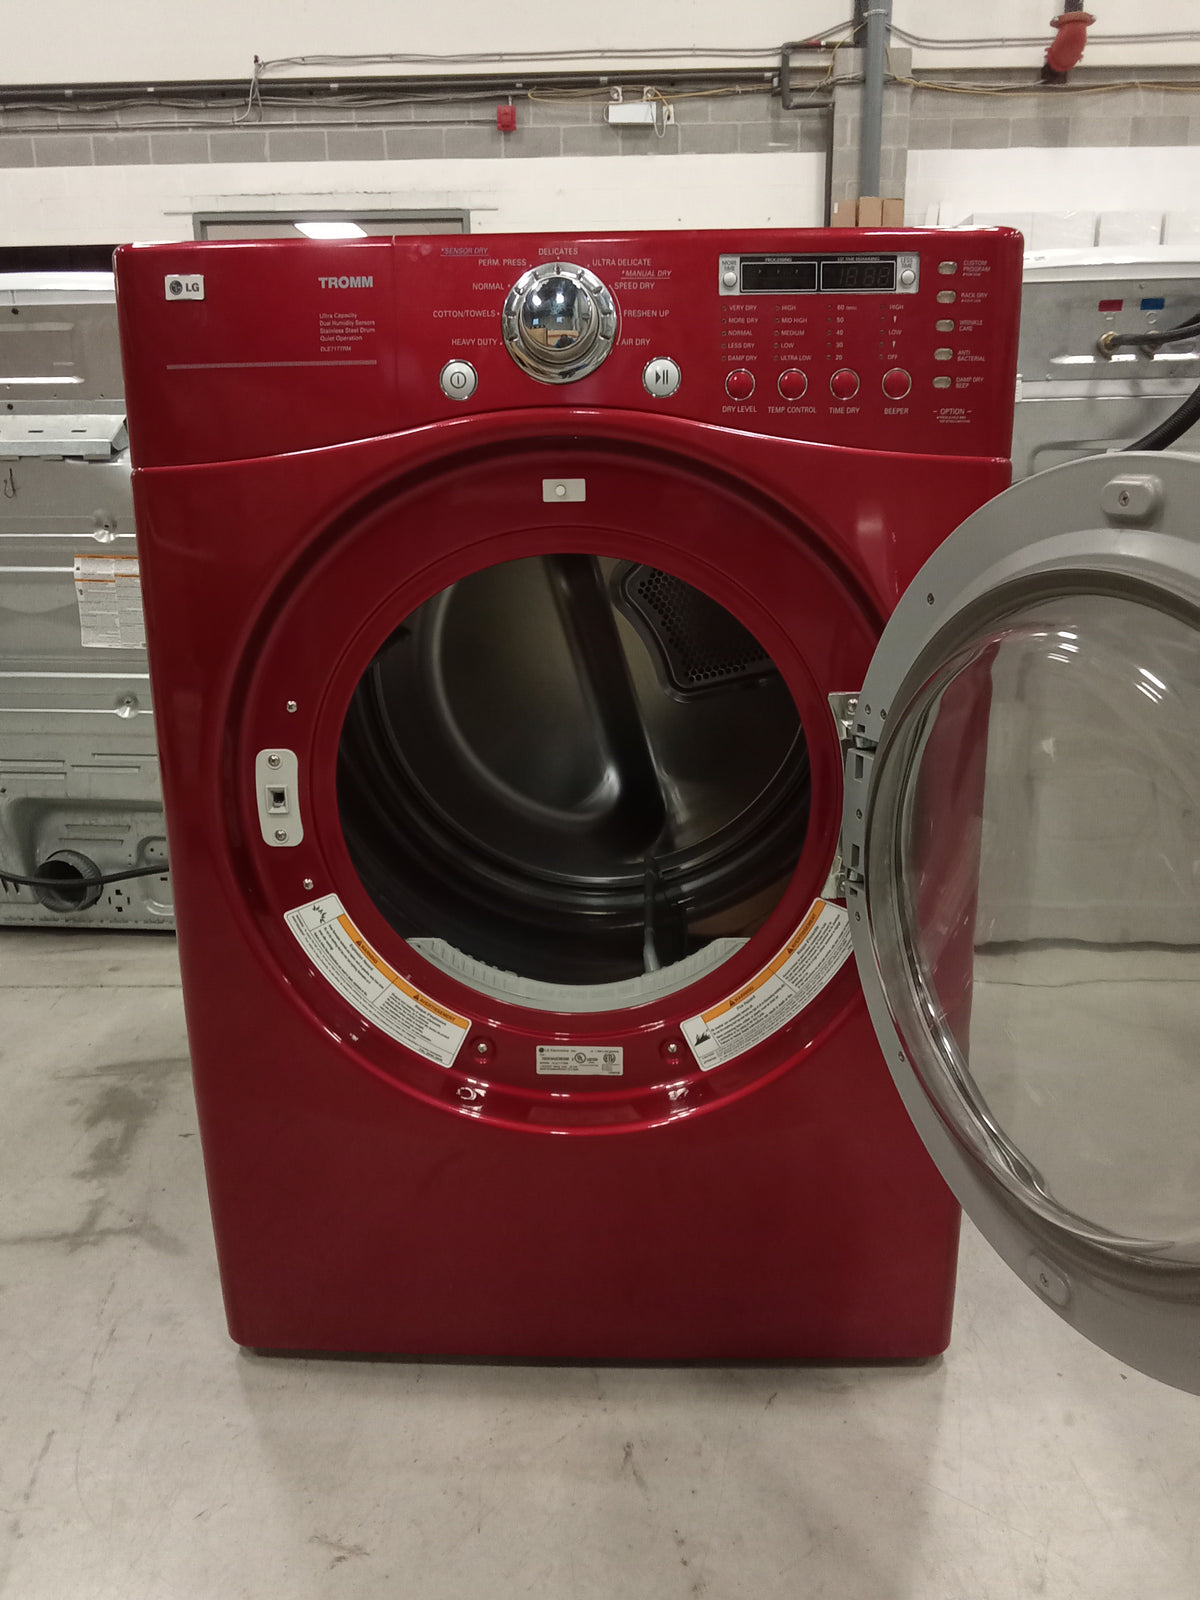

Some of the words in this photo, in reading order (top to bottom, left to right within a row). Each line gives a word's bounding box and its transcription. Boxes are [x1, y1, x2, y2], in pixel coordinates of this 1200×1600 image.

[592, 258, 616, 266] ULTRA
[618, 258, 651, 266] DELICATE
[318, 276, 373, 289] TROMM
[614, 282, 638, 290] SPEED
[640, 282, 655, 290] DRY
[186, 282, 199, 292] LG
[433, 309, 496, 318] COTTON/TOWELS
[452, 338, 475, 346] HEAVY
[477, 338, 497, 346] DUTY
[621, 338, 633, 346] AIR
[635, 338, 651, 346] DRY
[360, 944, 378, 964] WARNING
